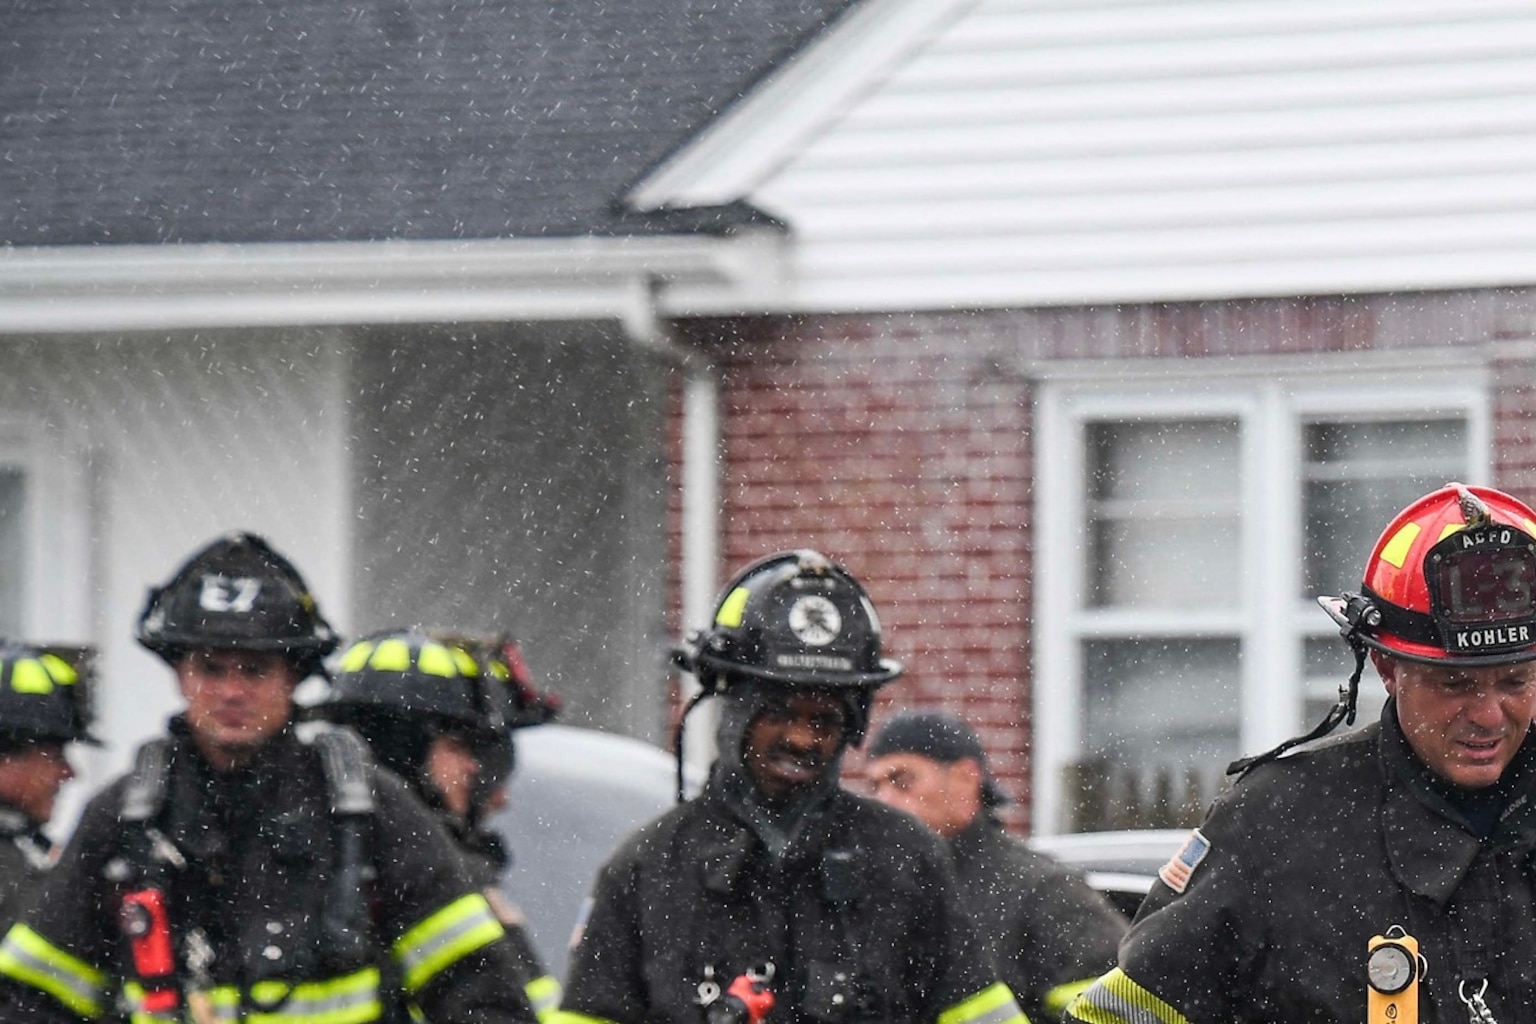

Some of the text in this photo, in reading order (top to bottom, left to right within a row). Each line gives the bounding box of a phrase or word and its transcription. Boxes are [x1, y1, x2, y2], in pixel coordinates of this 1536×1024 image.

[1462, 530, 1511, 549] ACFD
[200, 575, 262, 612] E7
[1457, 626, 1529, 647] KOHLER
